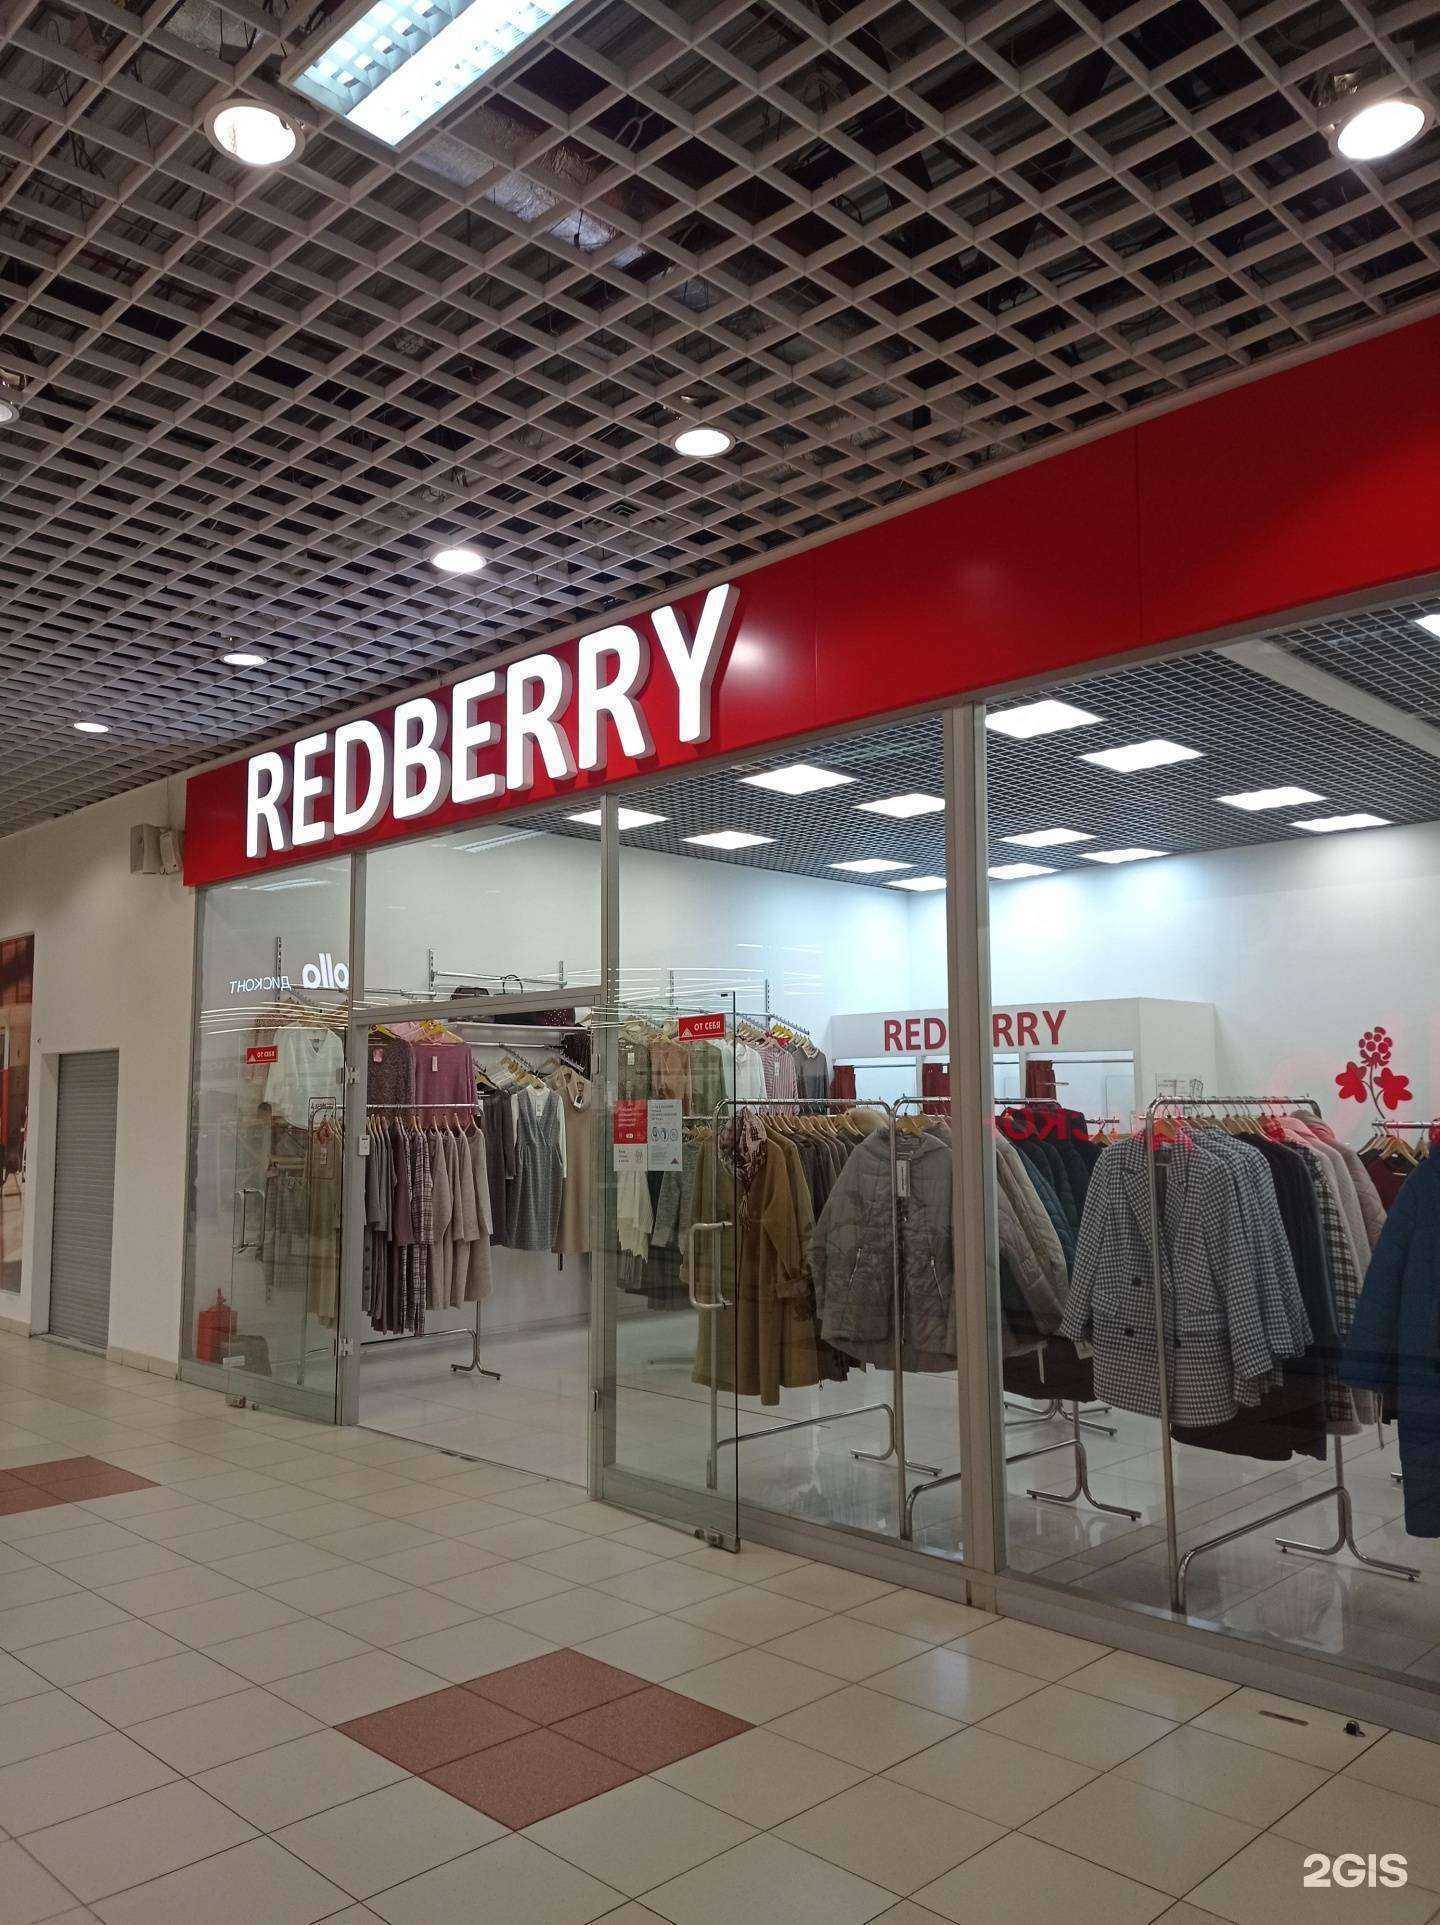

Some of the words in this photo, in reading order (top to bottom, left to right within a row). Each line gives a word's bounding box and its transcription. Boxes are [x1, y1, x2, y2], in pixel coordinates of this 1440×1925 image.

[246, 583, 739, 858] REDBERRY
[694, 1023, 703, 1031] ОТ
[704, 1021, 721, 1031] СЕБЯ
[884, 1010, 1067, 1052] REDRRY
